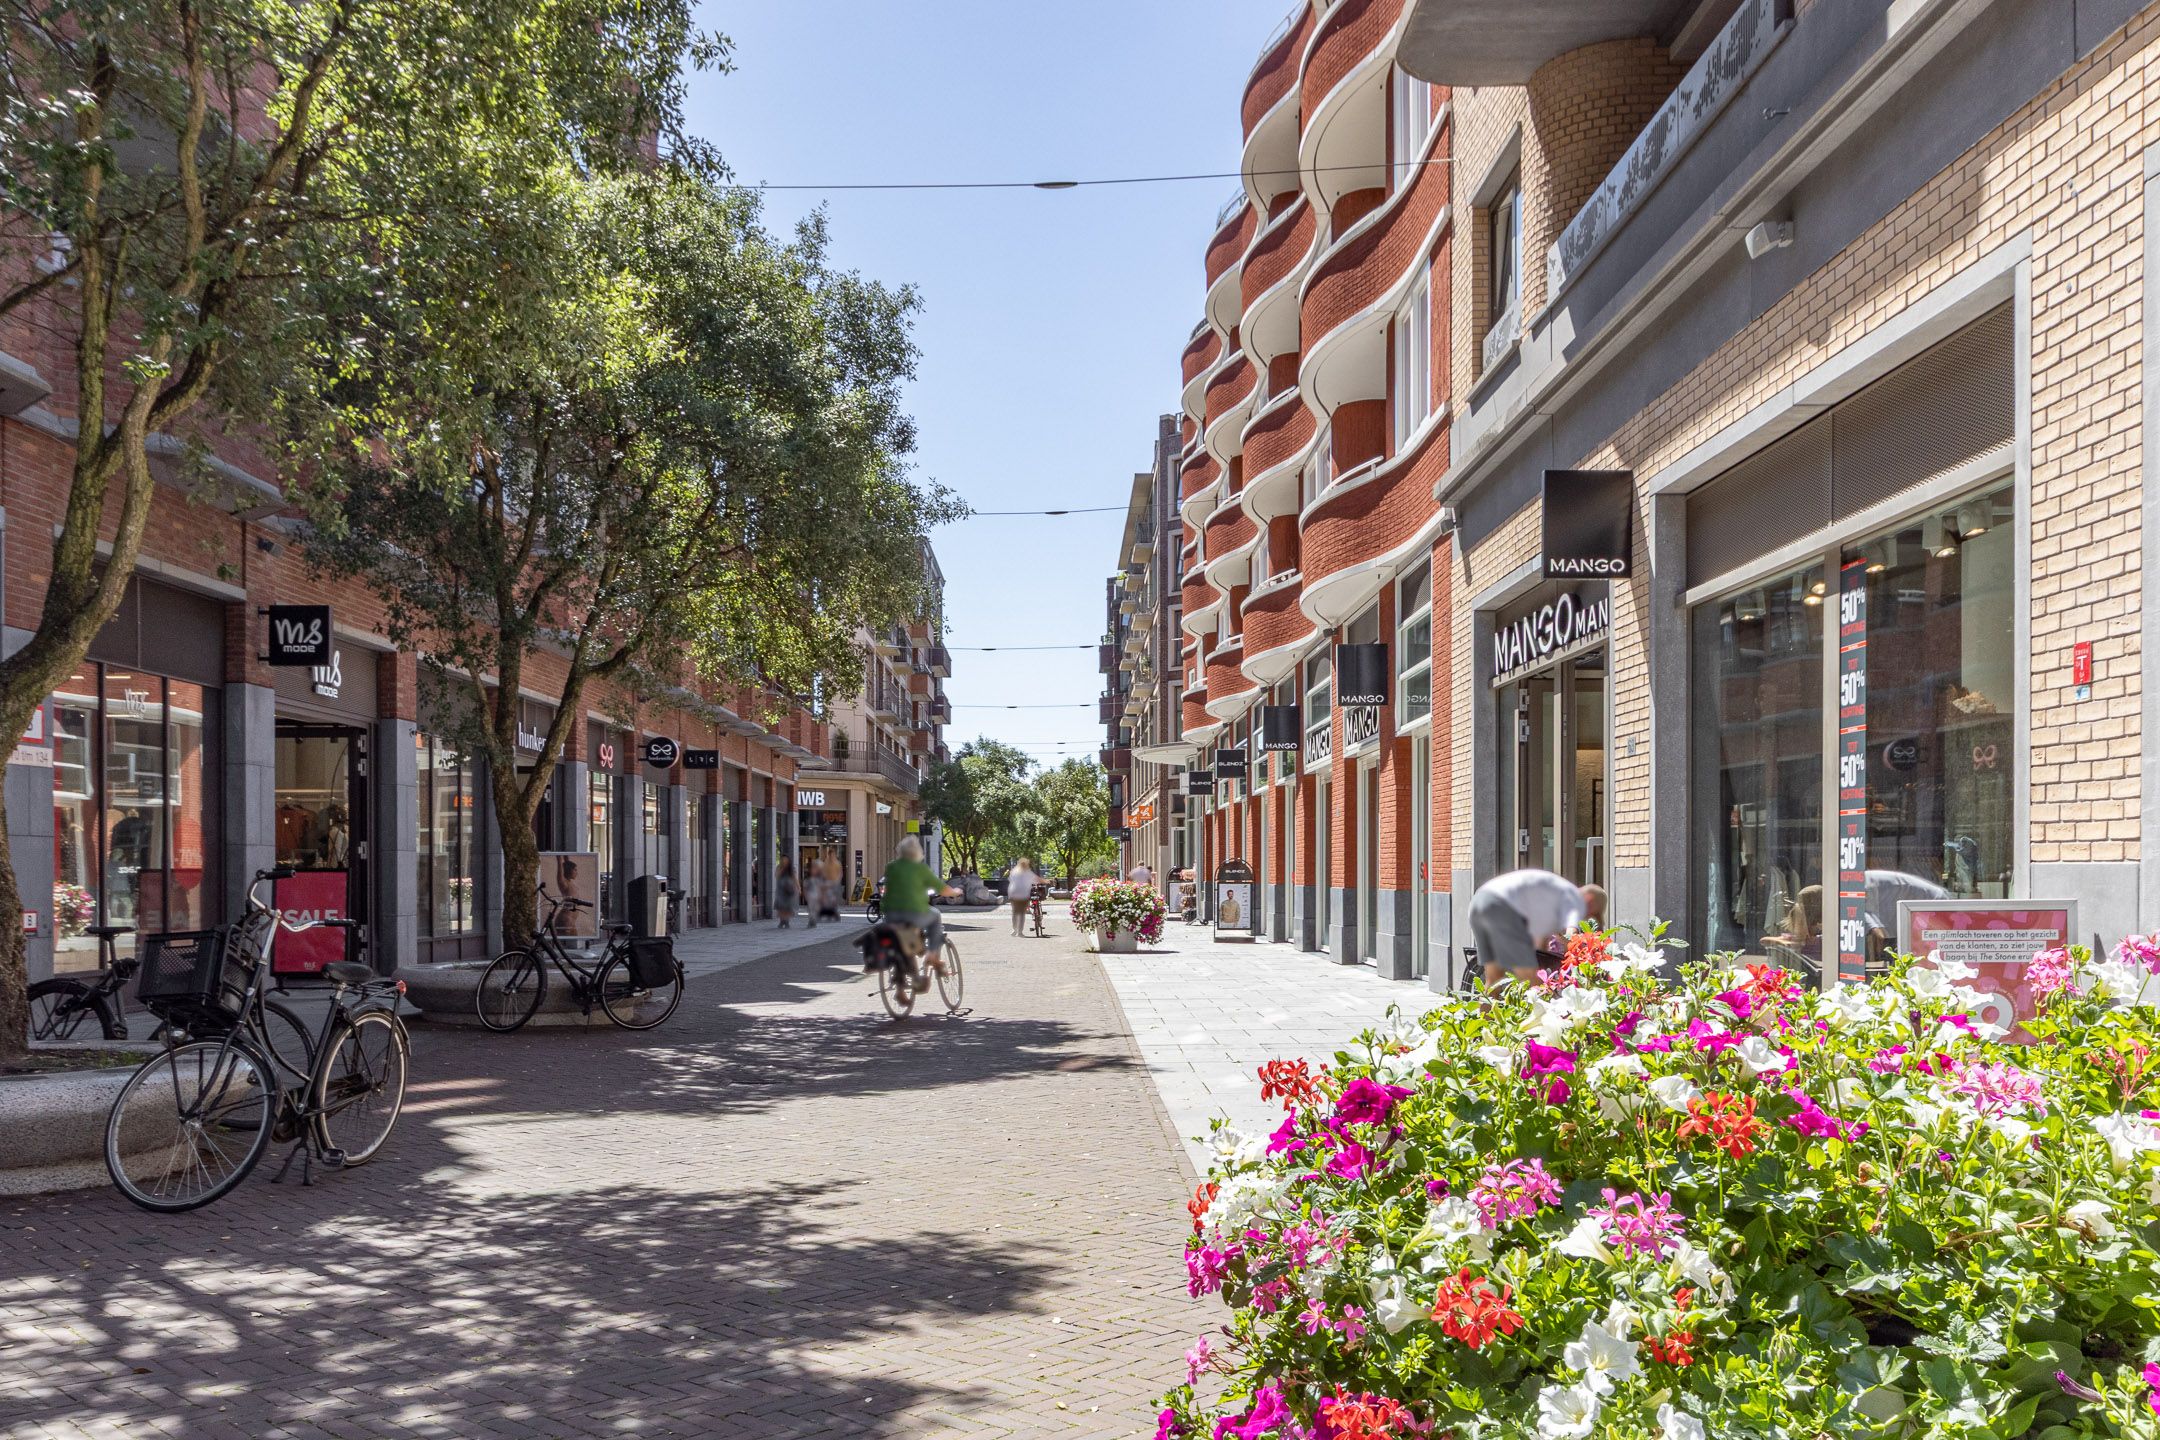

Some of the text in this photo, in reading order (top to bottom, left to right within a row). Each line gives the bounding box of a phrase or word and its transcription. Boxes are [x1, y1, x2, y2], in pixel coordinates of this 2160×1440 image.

[1550, 558, 1625, 573] MANGO
[1841, 587, 1866, 625] 50%
[1494, 593, 1609, 676] MANGO MAN
[1341, 694, 1385, 704] MANGO
[1840, 670, 1865, 707] 50%
[1346, 705, 1380, 746] MANGO
[1265, 742, 1298, 750] MANGO
[1306, 727, 1332, 764] MANGO
[1840, 754, 1865, 788] 50%
[1840, 837, 1865, 869] 50%
[283, 909, 339, 927] SALE
[1840, 919, 1865, 952] 50%
[1967, 942, 1997, 950] klanten,
[2011, 941, 2025, 949] ziet
[2026, 942, 2044, 950] jouw
[2030, 931, 2057, 940] gezicht
[1946, 952, 1966, 960] baan
[1967, 952, 1978, 961] bij
